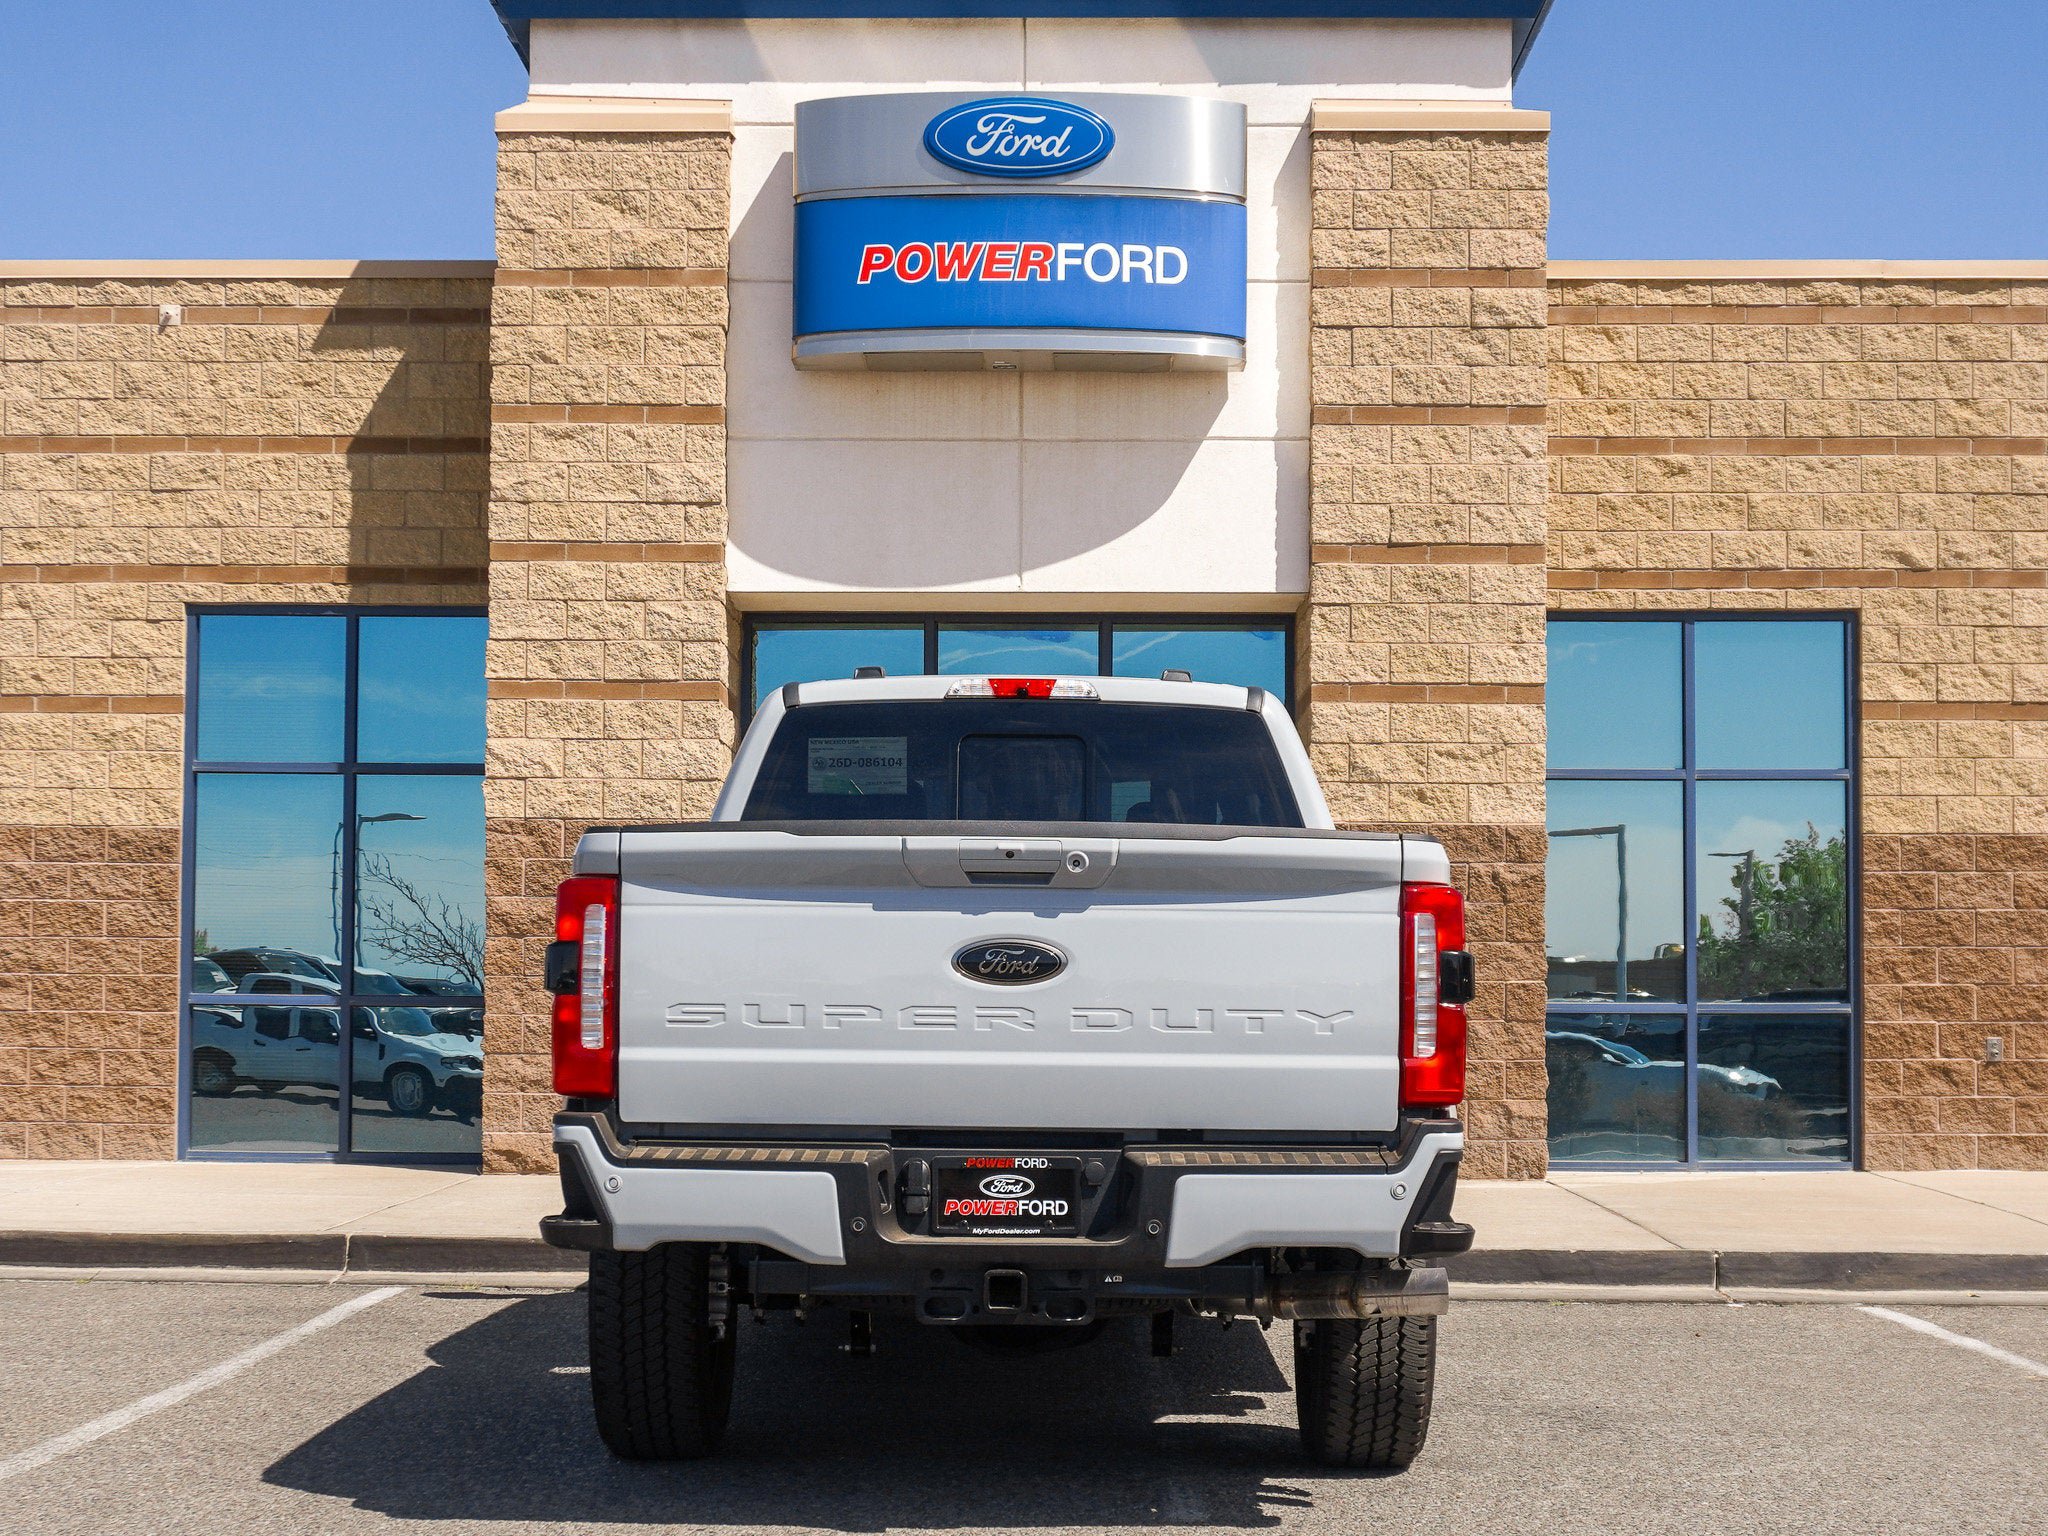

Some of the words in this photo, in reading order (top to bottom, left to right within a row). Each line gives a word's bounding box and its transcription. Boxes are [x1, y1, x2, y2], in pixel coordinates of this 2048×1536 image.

[966, 112, 1073, 158] Ford
[857, 242, 1188, 285] POWERFORD
[828, 757, 903, 768] 26D-086104
[979, 948, 1040, 975] Ford
[666, 1003, 1035, 1032] SUPER
[1070, 1008, 1353, 1035] DUTY
[966, 1157, 1048, 1169] POWERFORD
[990, 1178, 1023, 1193] Ford
[944, 1199, 1069, 1216] POWERFORD
